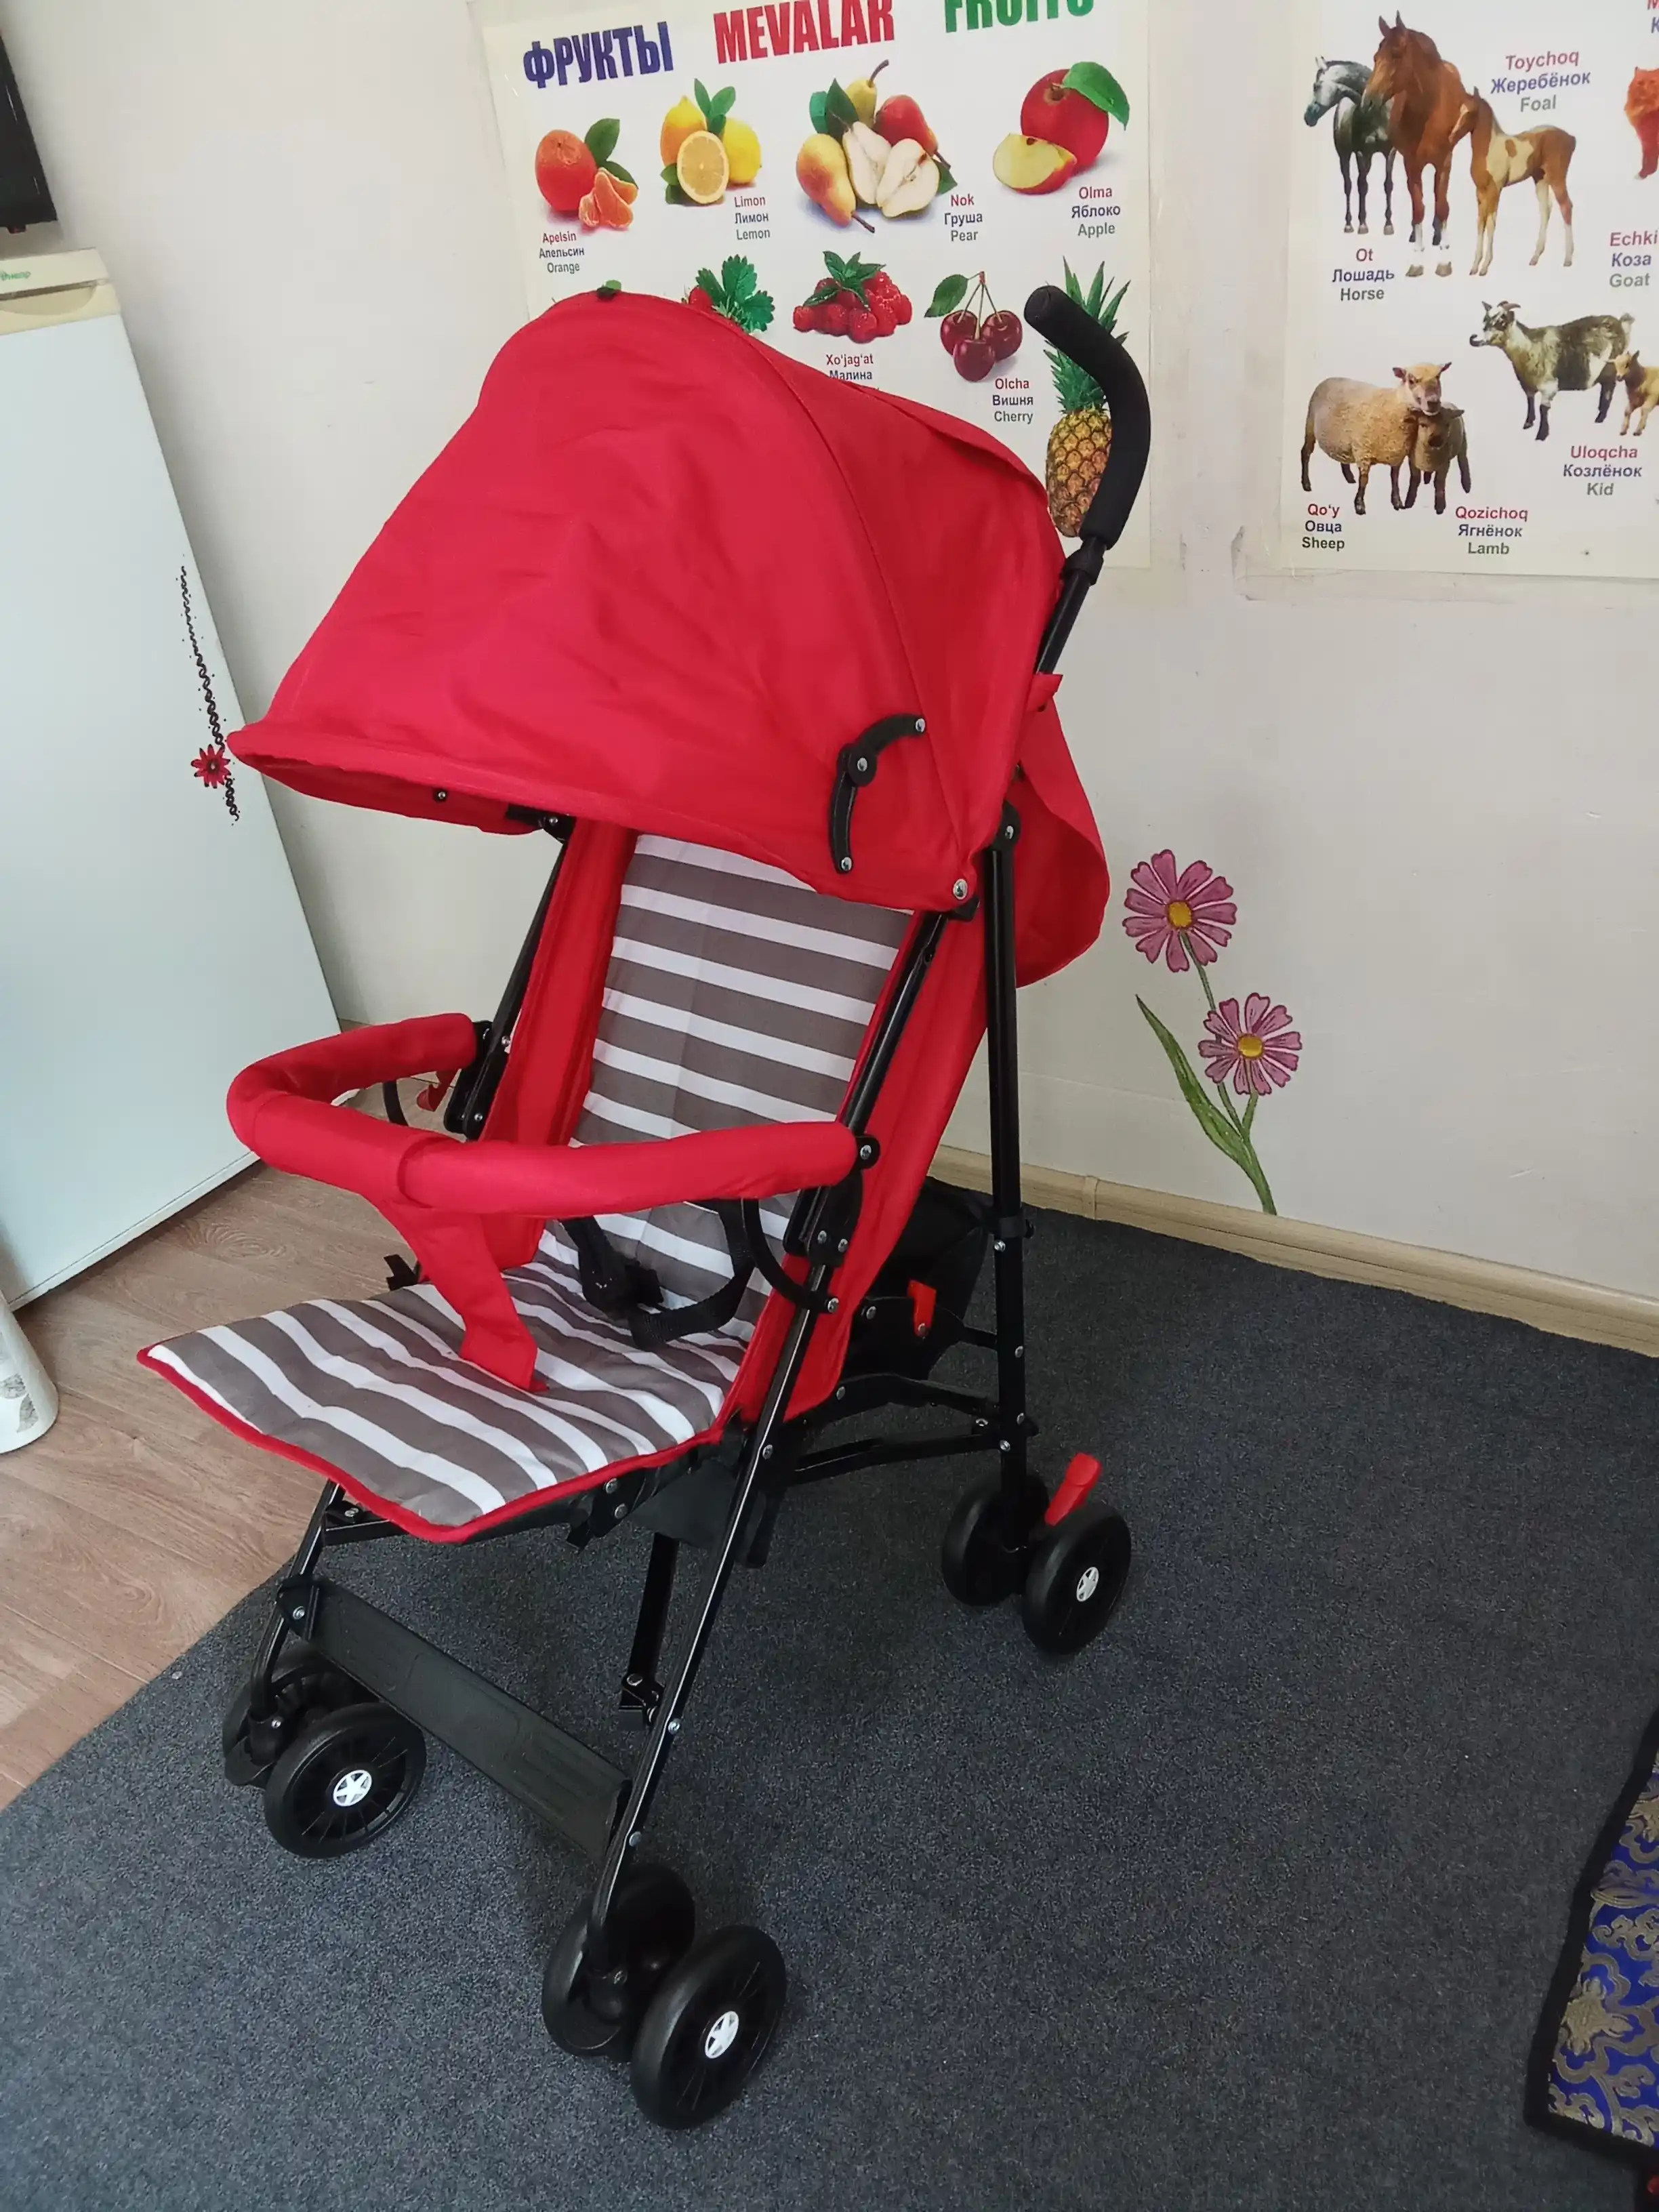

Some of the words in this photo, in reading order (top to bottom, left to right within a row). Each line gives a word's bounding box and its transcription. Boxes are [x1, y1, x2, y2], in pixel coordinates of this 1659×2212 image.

[714, 0, 894, 64] MEVALAR
[523, 22, 674, 89] ФРУКТЫ
[1506, 52, 1579, 73] Toychoq
[1491, 72, 1591, 94] Жеребёнок
[1521, 96, 1556, 112] Foal
[1079, 186, 1112, 199] Olma
[735, 196, 765, 207] Limon
[951, 194, 974, 207] Nok
[1072, 205, 1120, 218] Яблоко
[735, 213, 769, 224] Лимон
[945, 213, 983, 227] Груша
[737, 230, 770, 240] Lemon
[951, 230, 978, 241] Pear
[1078, 222, 1115, 238] Apple
[543, 231, 576, 245] Apelsin
[1610, 230, 1658, 246] Echki
[539, 248, 584, 258] Апельсин
[1356, 249, 1372, 262] Ot
[1612, 253, 1651, 266] Коза
[547, 262, 579, 274] Orange
[1332, 269, 1394, 282] Лошадь
[1610, 273, 1650, 287] Goat
[1341, 288, 1384, 301] Horse
[830, 370, 872, 380] Малина
[996, 378, 1029, 389] Olcha
[993, 395, 1033, 405] Вишня
[994, 411, 1033, 424] Cherry
[1571, 445, 1637, 461] Uloqcha
[1563, 464, 1642, 476] Козлёнок
[1587, 483, 1614, 495] Kid
[1456, 506, 1528, 522] Qozichoq
[1305, 520, 1341, 533] Овца
[1458, 524, 1522, 537] Ягнёнок
[1303, 537, 1345, 552] Sheep
[1469, 542, 1509, 554] Lamb
